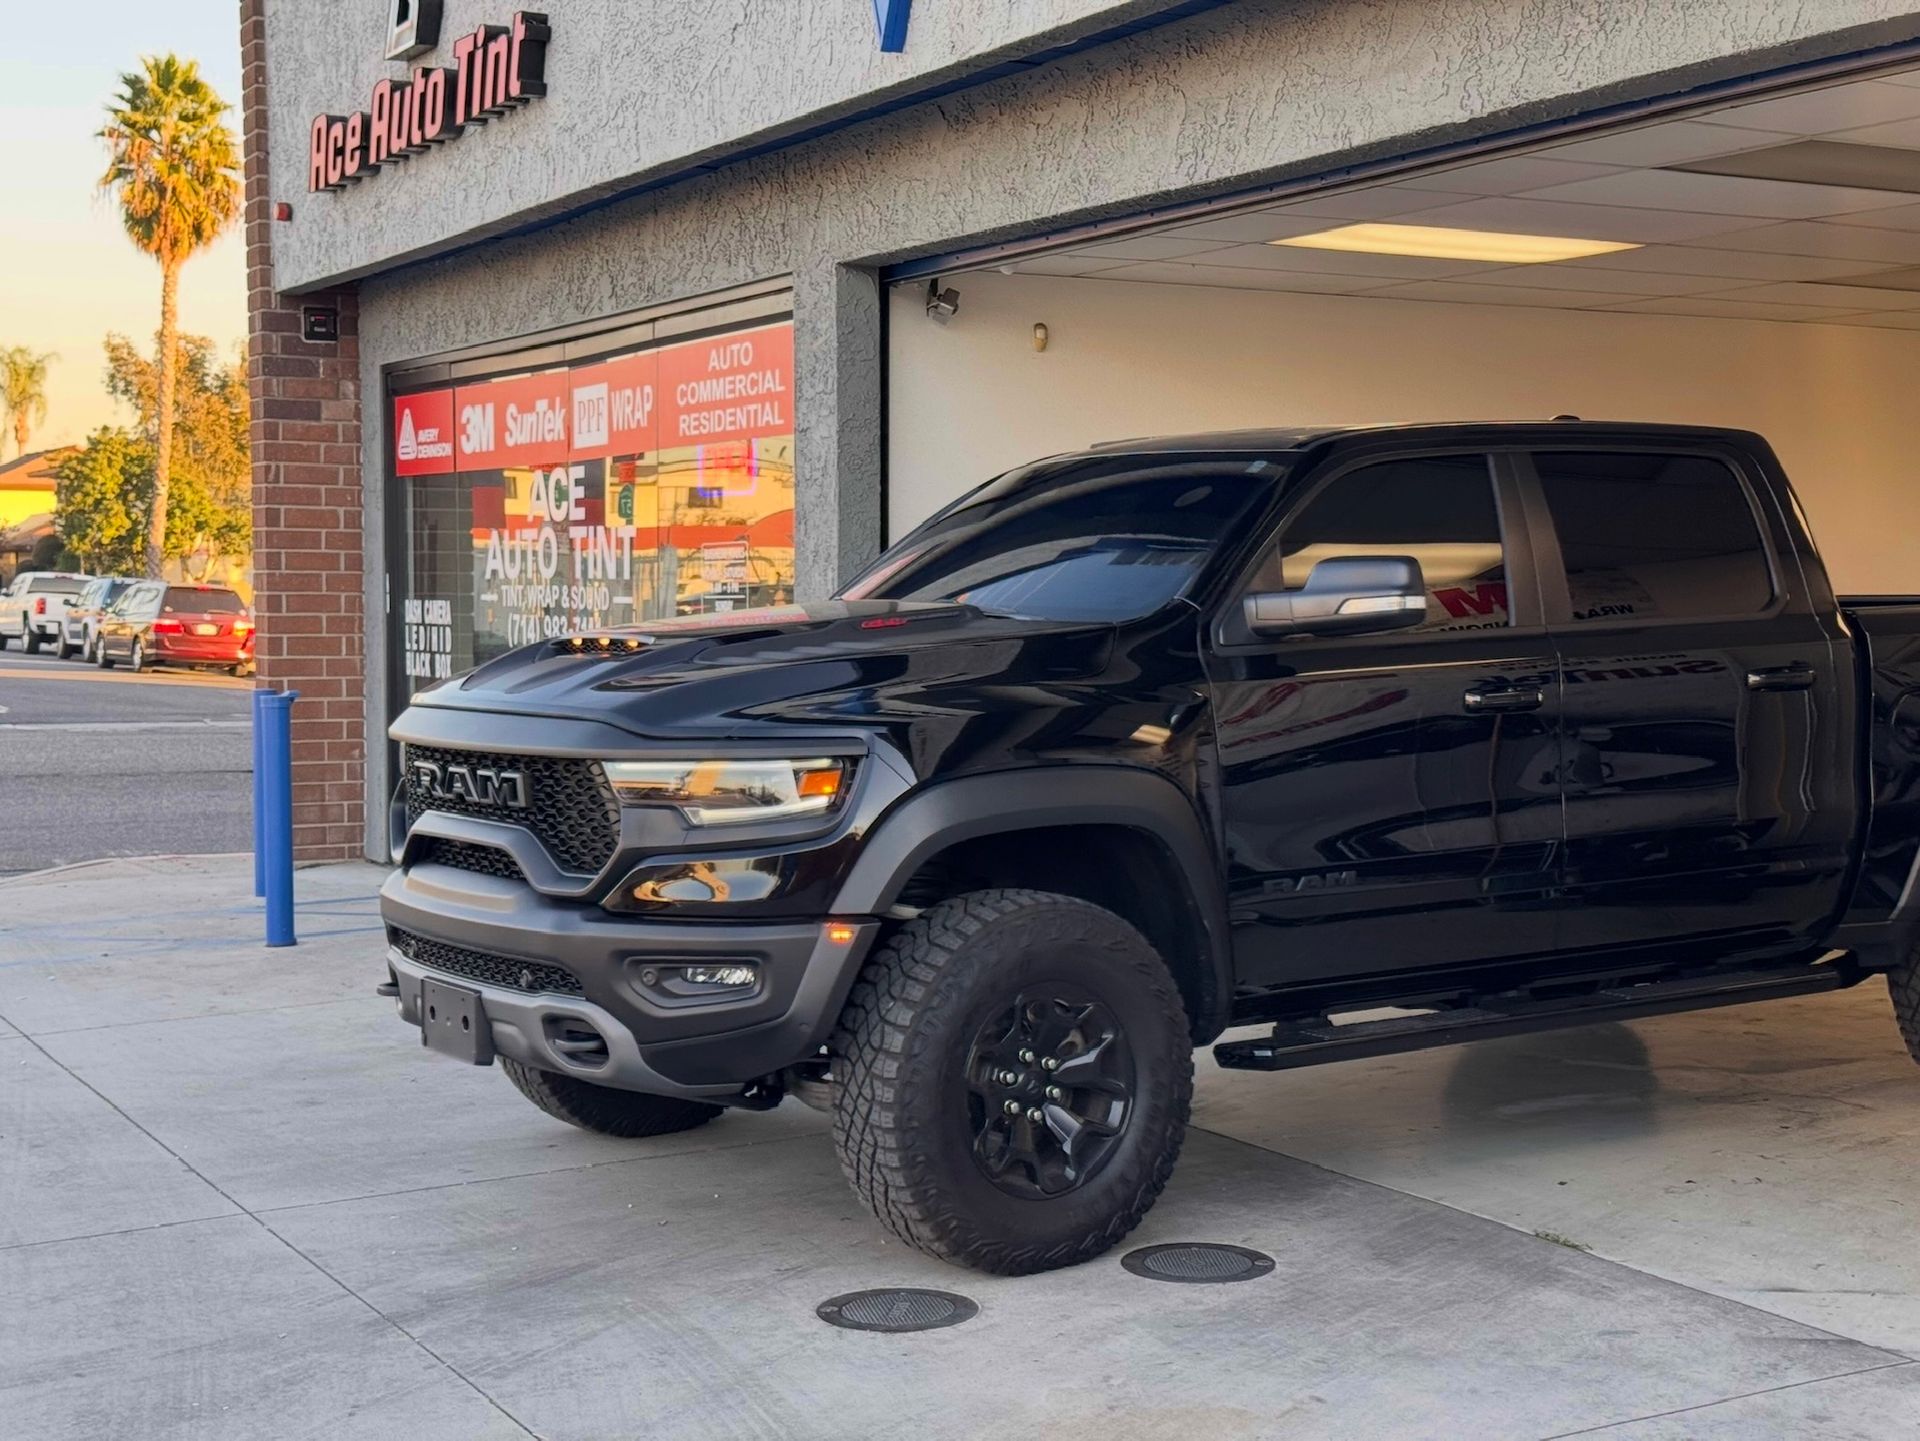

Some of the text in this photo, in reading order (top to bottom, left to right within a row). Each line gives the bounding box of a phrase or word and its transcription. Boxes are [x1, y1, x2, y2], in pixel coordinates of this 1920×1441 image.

[308, 113, 362, 193] Ace
[369, 67, 445, 165] Auto
[454, 11, 526, 126] Tint
[708, 341, 753, 372] AUTO
[676, 368, 786, 406] COMMERCIAL
[460, 396, 567, 454] 3M SunTek
[577, 384, 653, 435] PPF WRAP
[679, 401, 785, 436] RESIDENTIAL
[527, 465, 586, 522] ACE
[485, 525, 637, 580] AUTO TINT
[561, 585, 570, 609] &
[570, 585, 610, 611] SOUND
[434, 653, 452, 680] BOX
[413, 760, 528, 808] RAM
[1263, 870, 1358, 894] RAM
